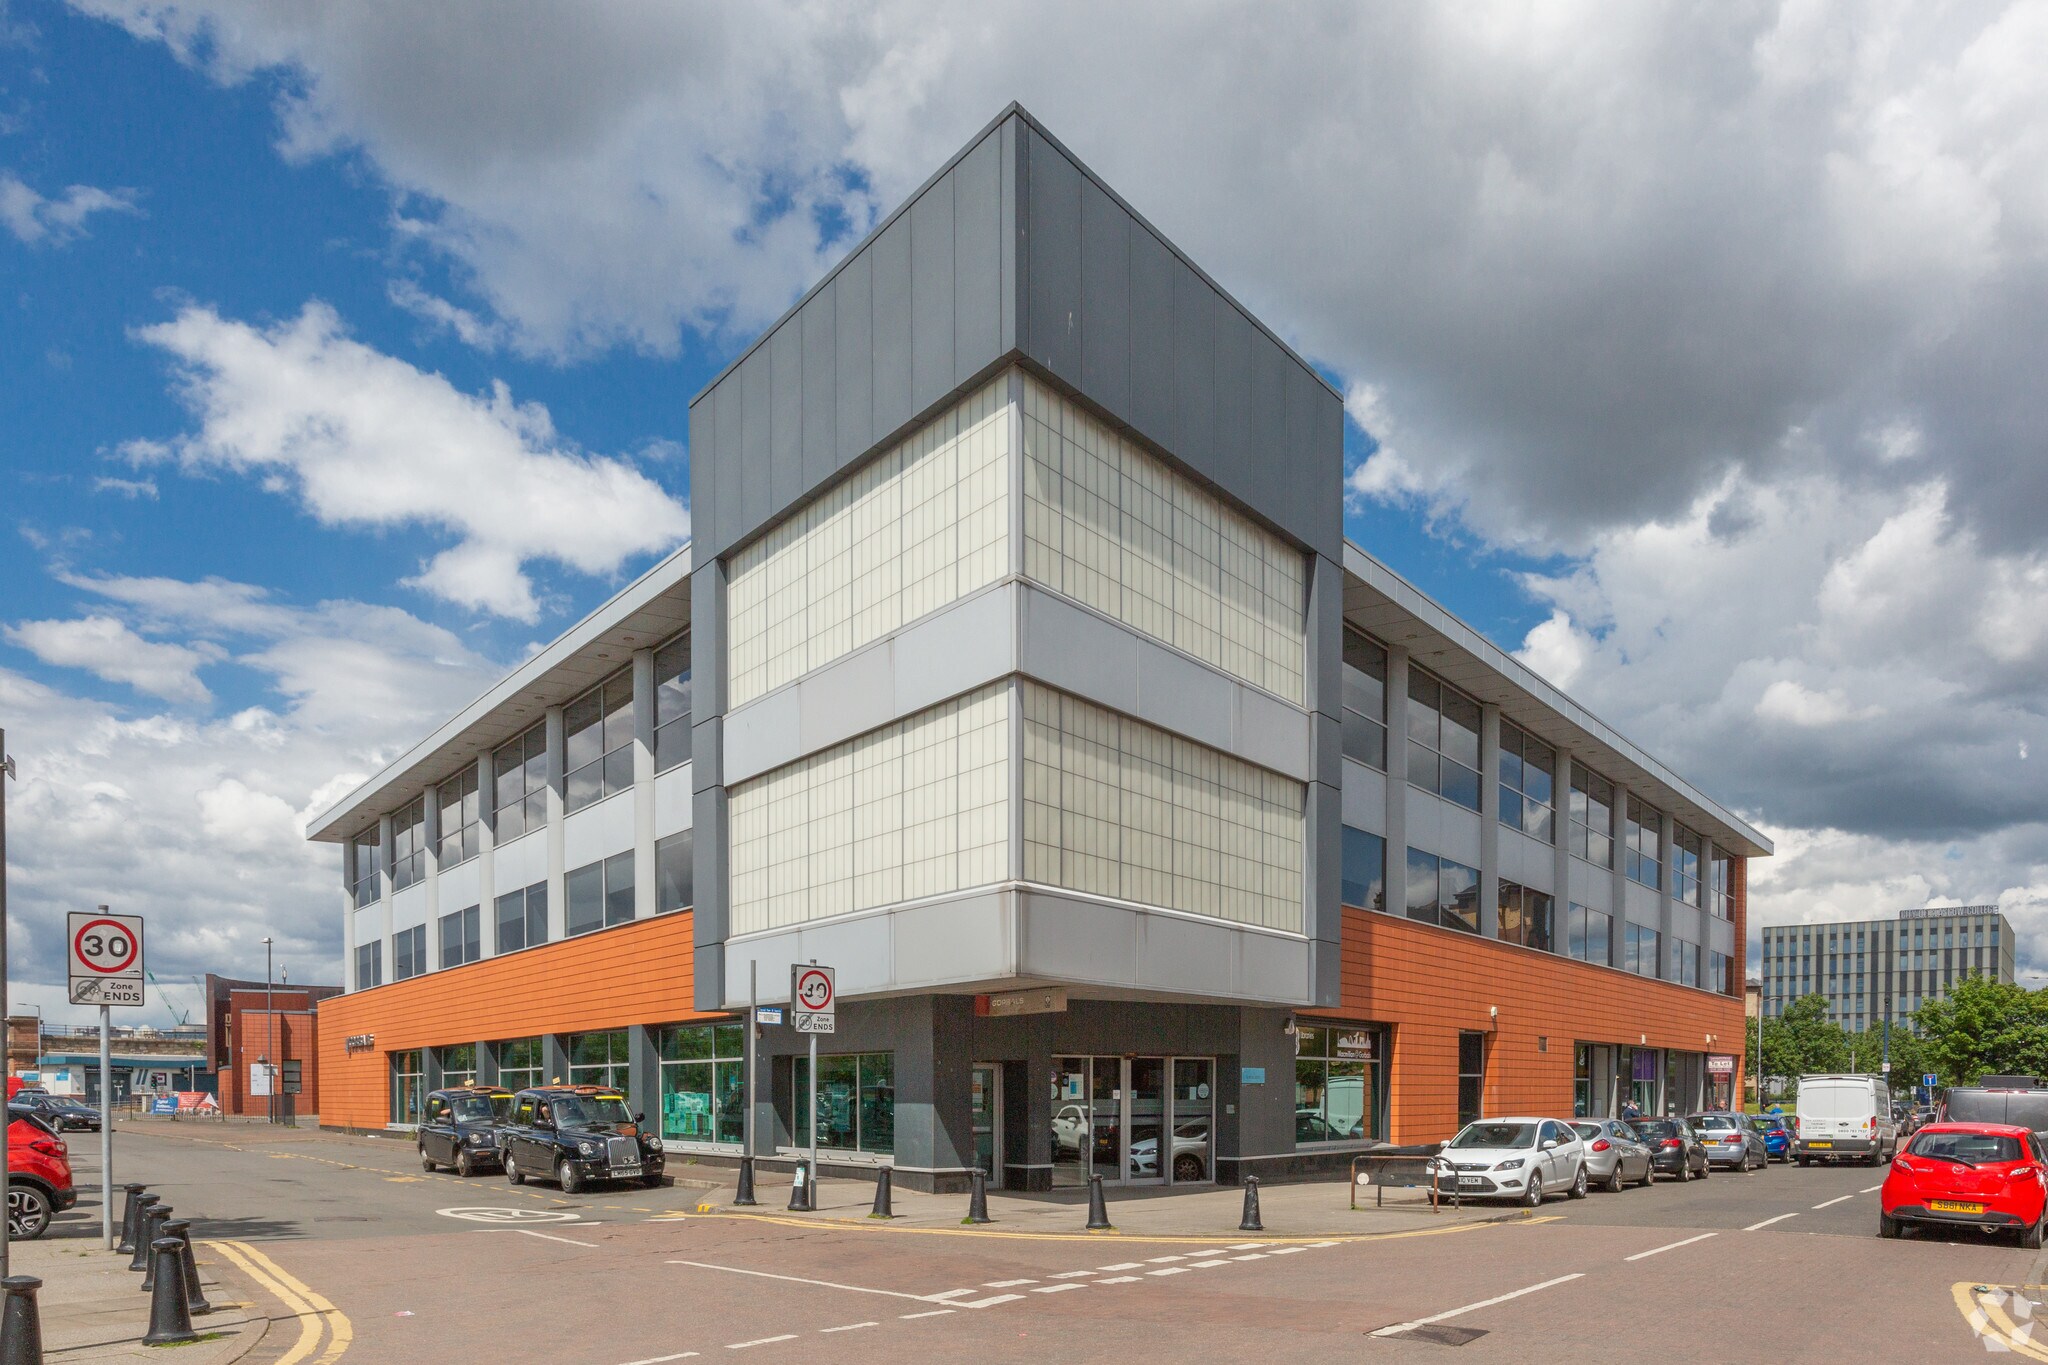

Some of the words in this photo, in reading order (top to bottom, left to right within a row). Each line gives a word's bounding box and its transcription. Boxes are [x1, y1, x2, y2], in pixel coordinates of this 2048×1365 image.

[84, 935, 128, 957] 30
[110, 982, 134, 990] Zone
[804, 982, 827, 998] 30
[104, 991, 140, 1001] ENDS
[1959, 1203, 1977, 1211] NKA
